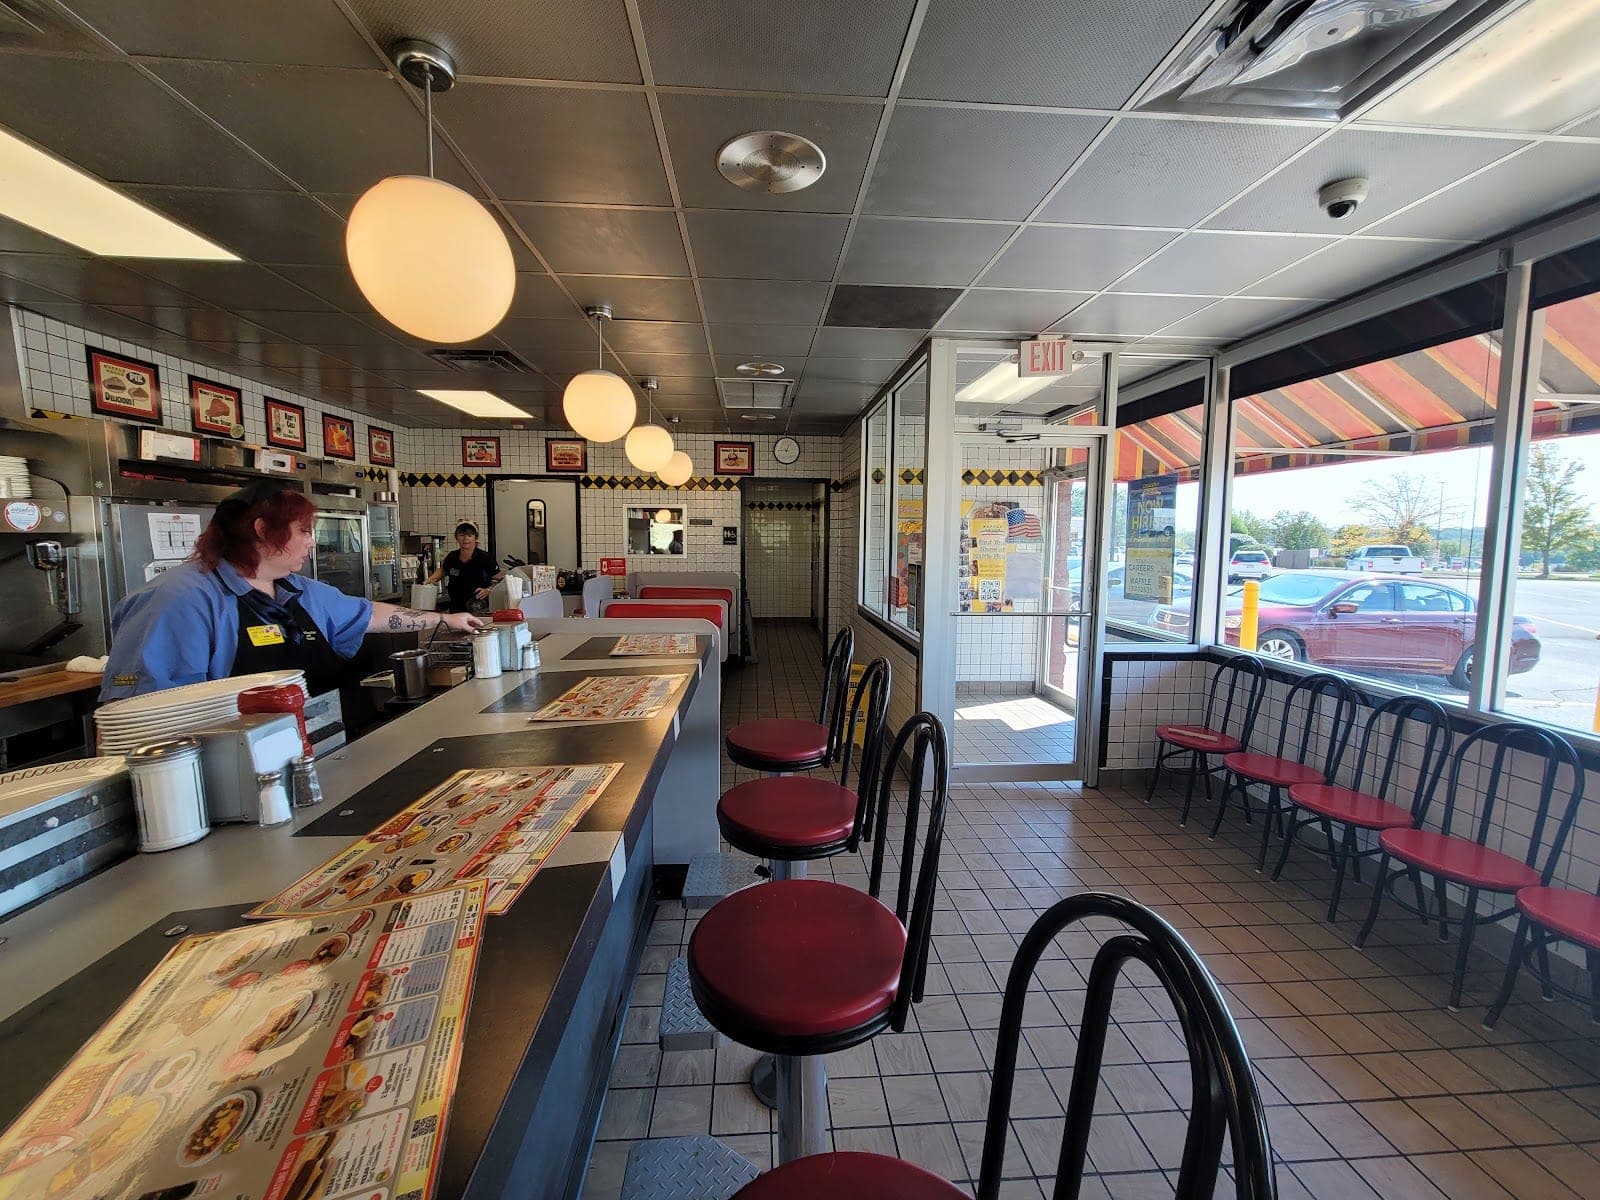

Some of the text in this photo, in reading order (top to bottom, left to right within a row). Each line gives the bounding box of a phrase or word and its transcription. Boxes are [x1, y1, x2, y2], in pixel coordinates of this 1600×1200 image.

[1030, 341, 1066, 372] EXIT
[129, 372, 143, 382] PIE
[1137, 498, 1163, 514] NOW
[1128, 564, 1154, 573] CAREERS
[1130, 576, 1152, 586] WAFFLE
